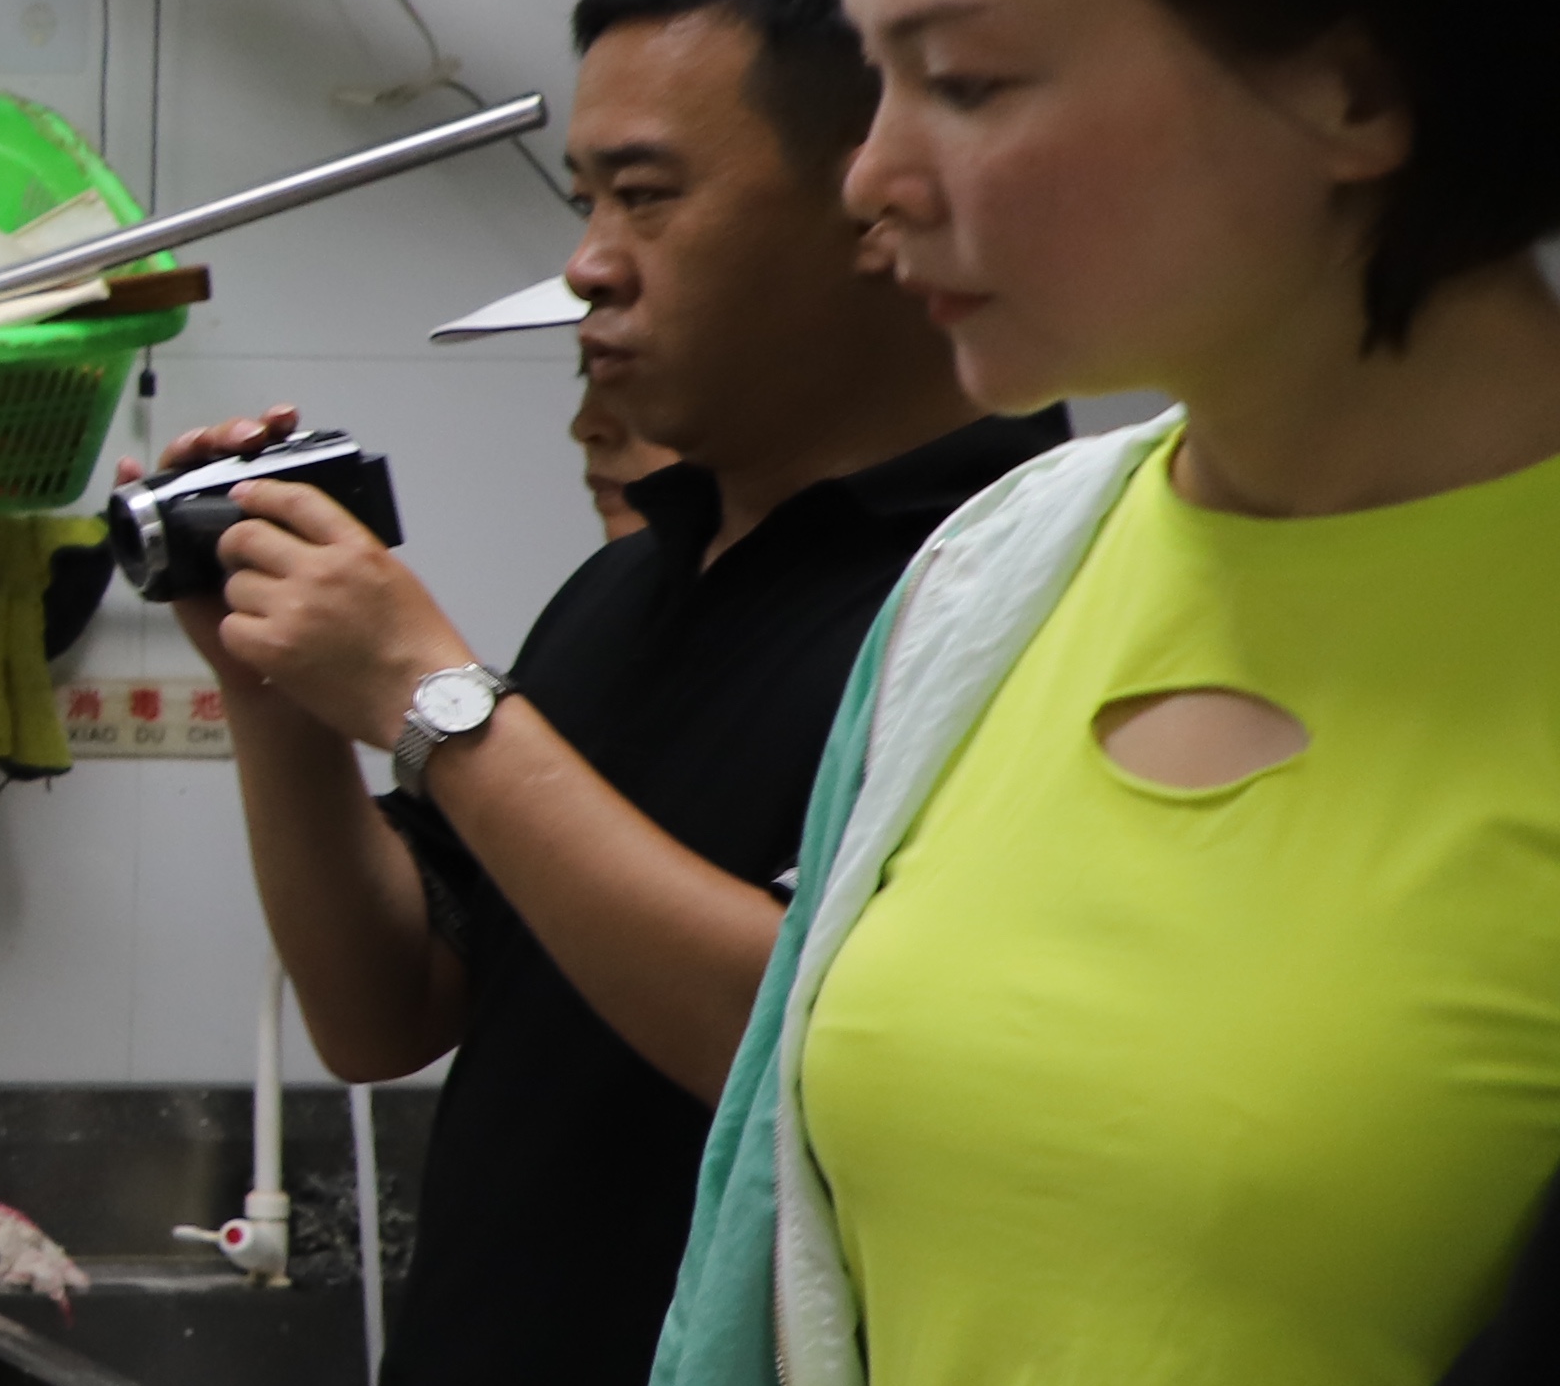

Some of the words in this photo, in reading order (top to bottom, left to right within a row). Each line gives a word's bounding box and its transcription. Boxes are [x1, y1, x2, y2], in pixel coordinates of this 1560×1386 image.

[68, 688, 223, 721] 消毒池
[135, 726, 166, 743] DU
